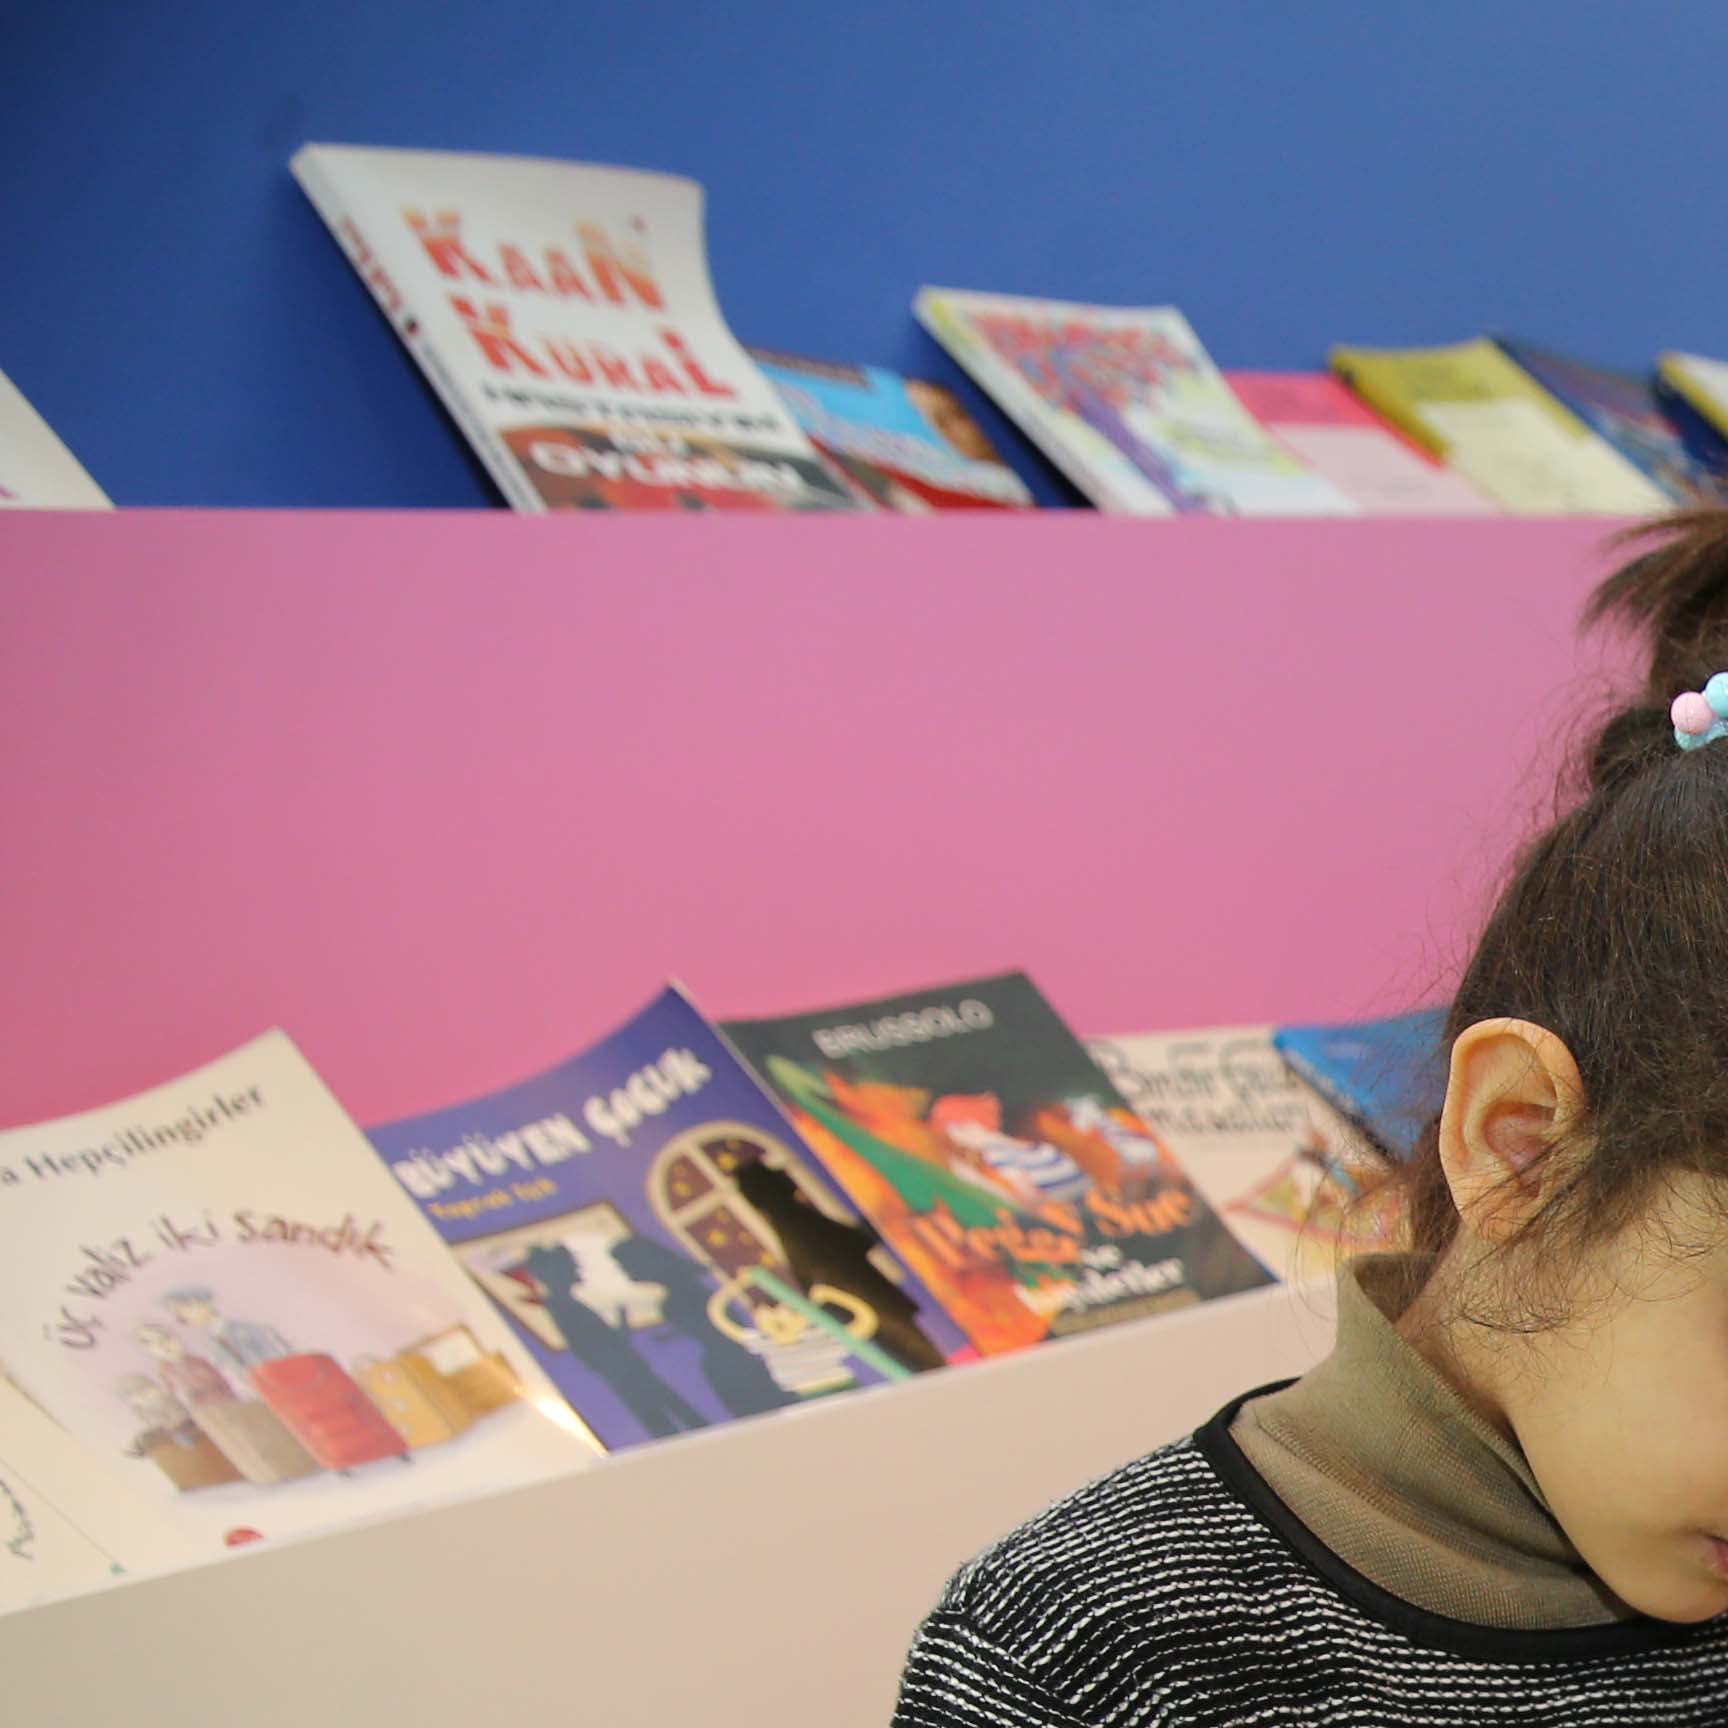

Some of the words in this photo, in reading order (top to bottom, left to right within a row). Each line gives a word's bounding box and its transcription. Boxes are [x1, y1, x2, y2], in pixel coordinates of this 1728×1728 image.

[812, 999, 995, 1060] BRUSSOLO
[25, 1084, 264, 1177] Hepçilingirler
[392, 1131, 592, 1199] BÜYÜYEN
[582, 1046, 713, 1148] ÇOCUK
[1083, 1187, 1193, 1238] Sue
